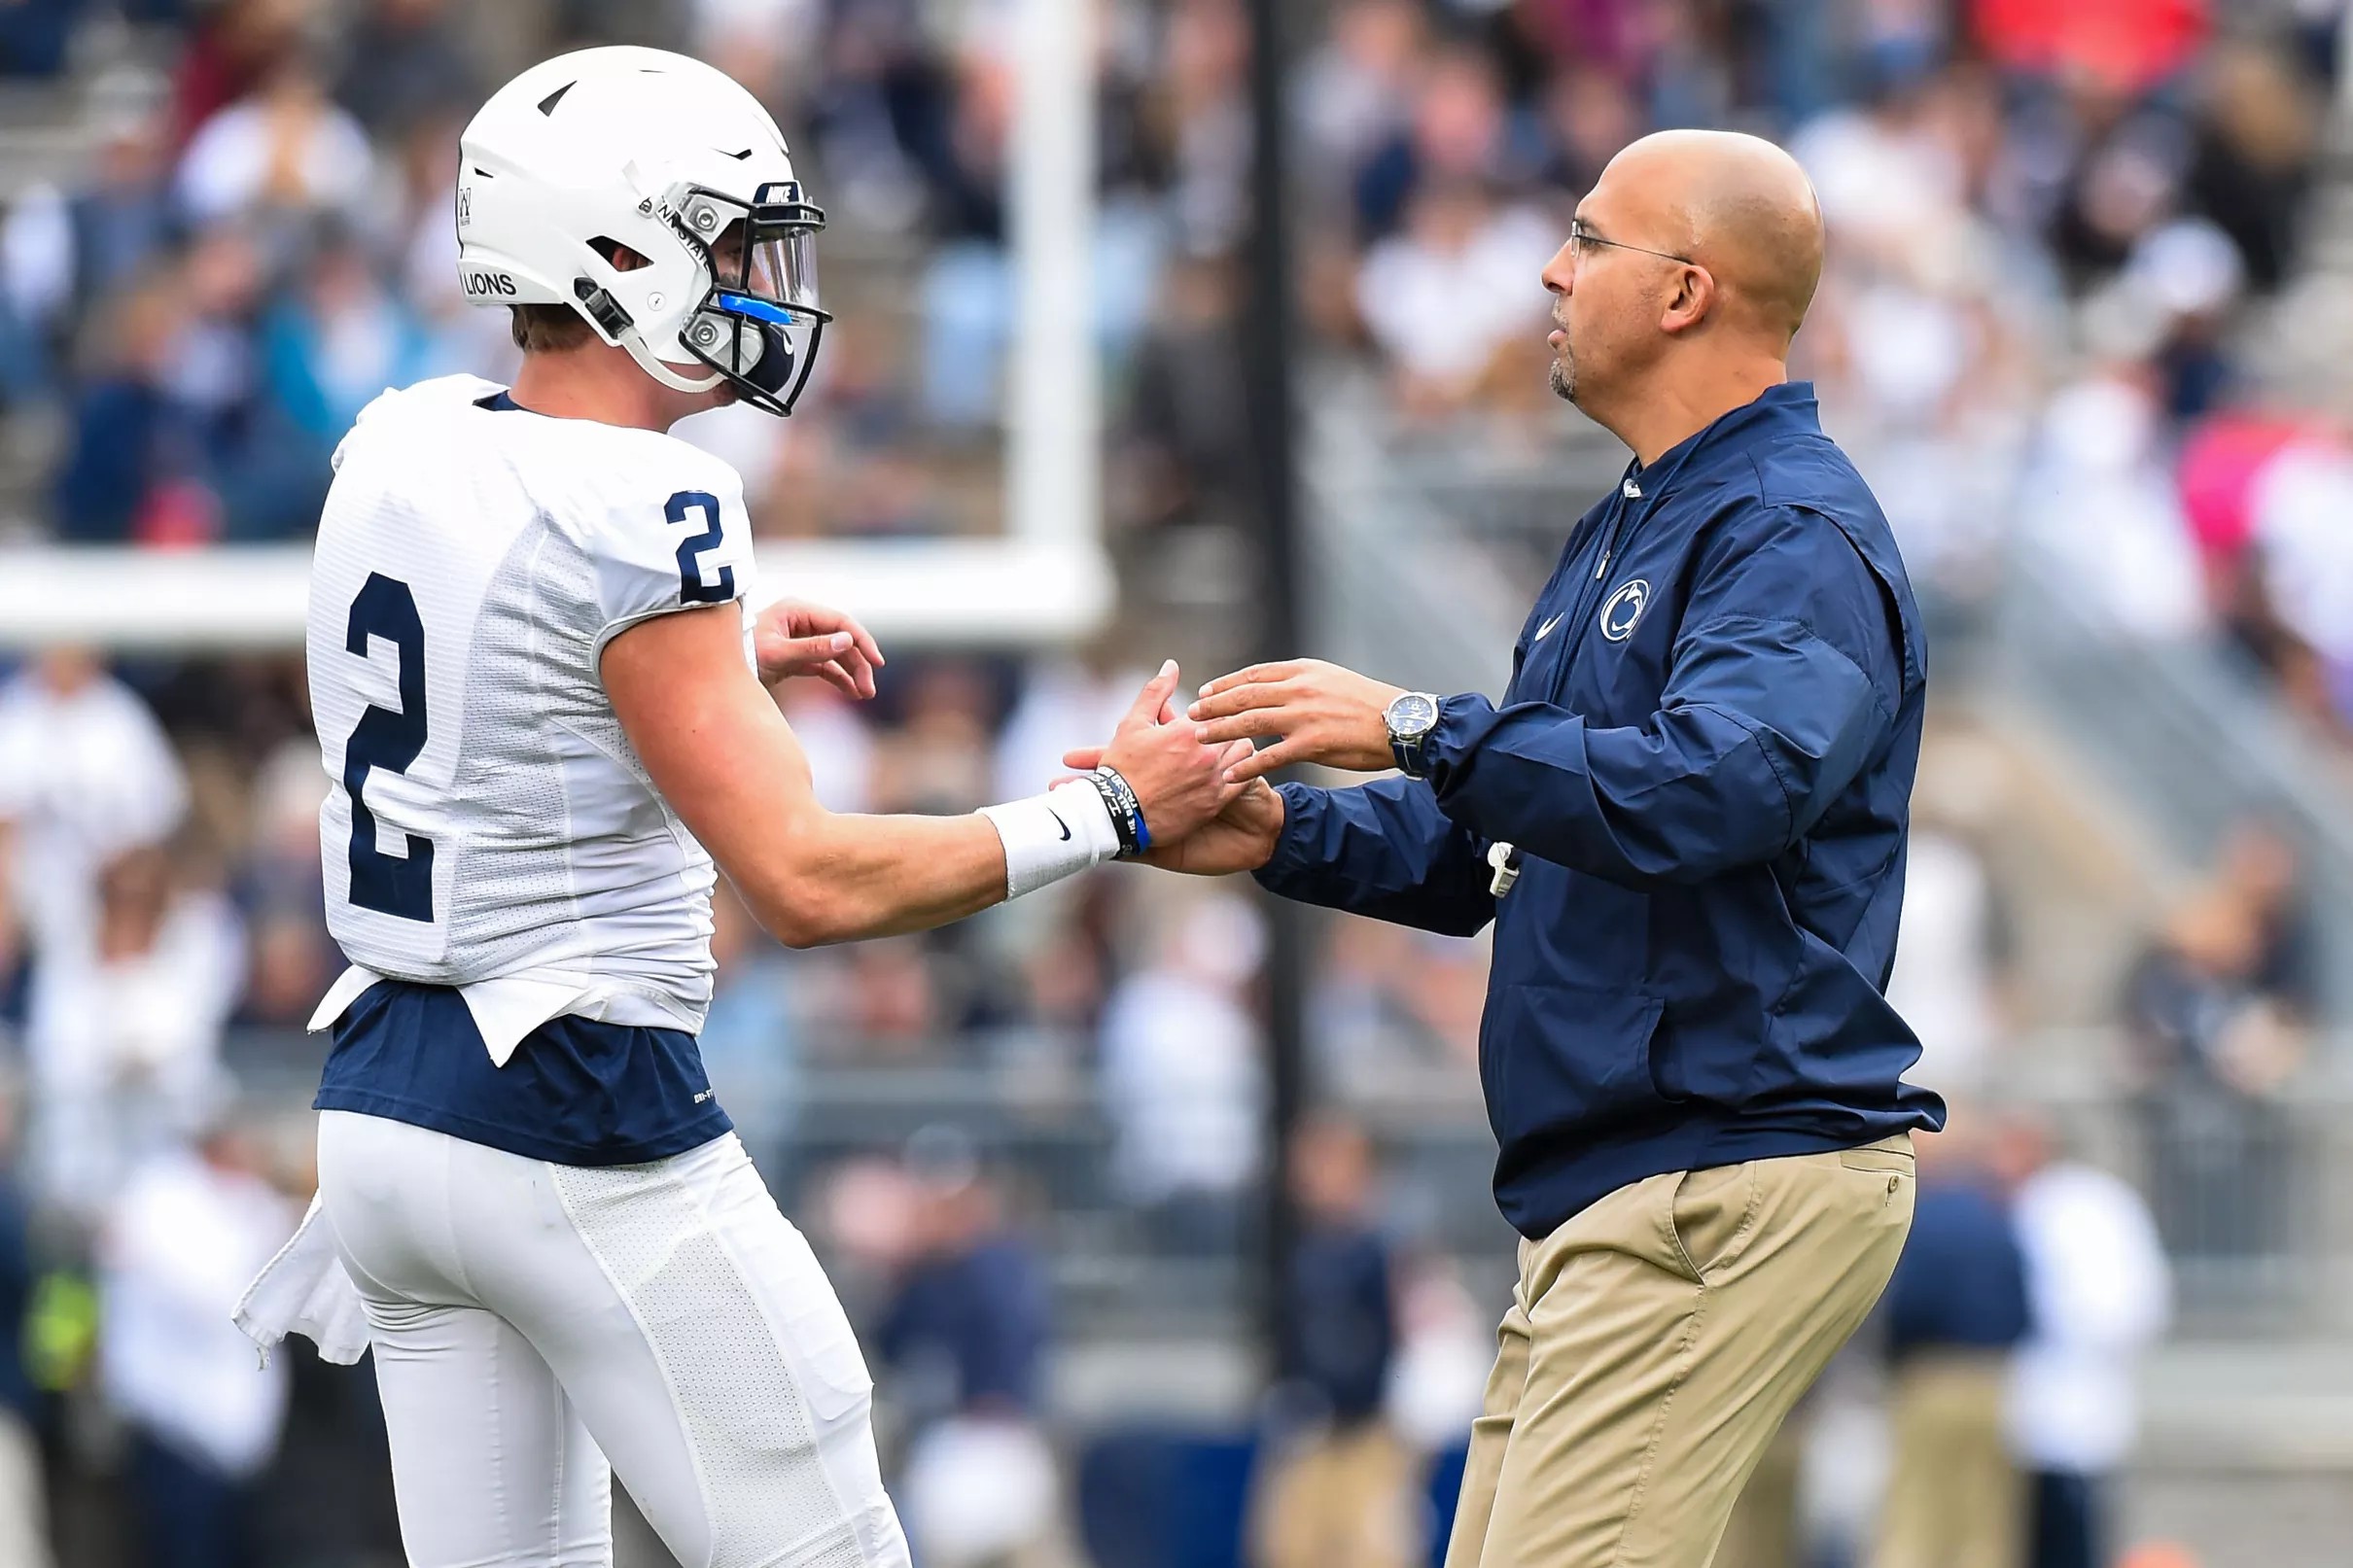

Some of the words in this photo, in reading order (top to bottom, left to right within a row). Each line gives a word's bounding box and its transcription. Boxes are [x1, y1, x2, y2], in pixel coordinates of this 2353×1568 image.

[766, 186, 791, 203] NIKE
[464, 273, 517, 296] LIONS
[664, 490, 735, 604] 2
[343, 571, 436, 923] 2
